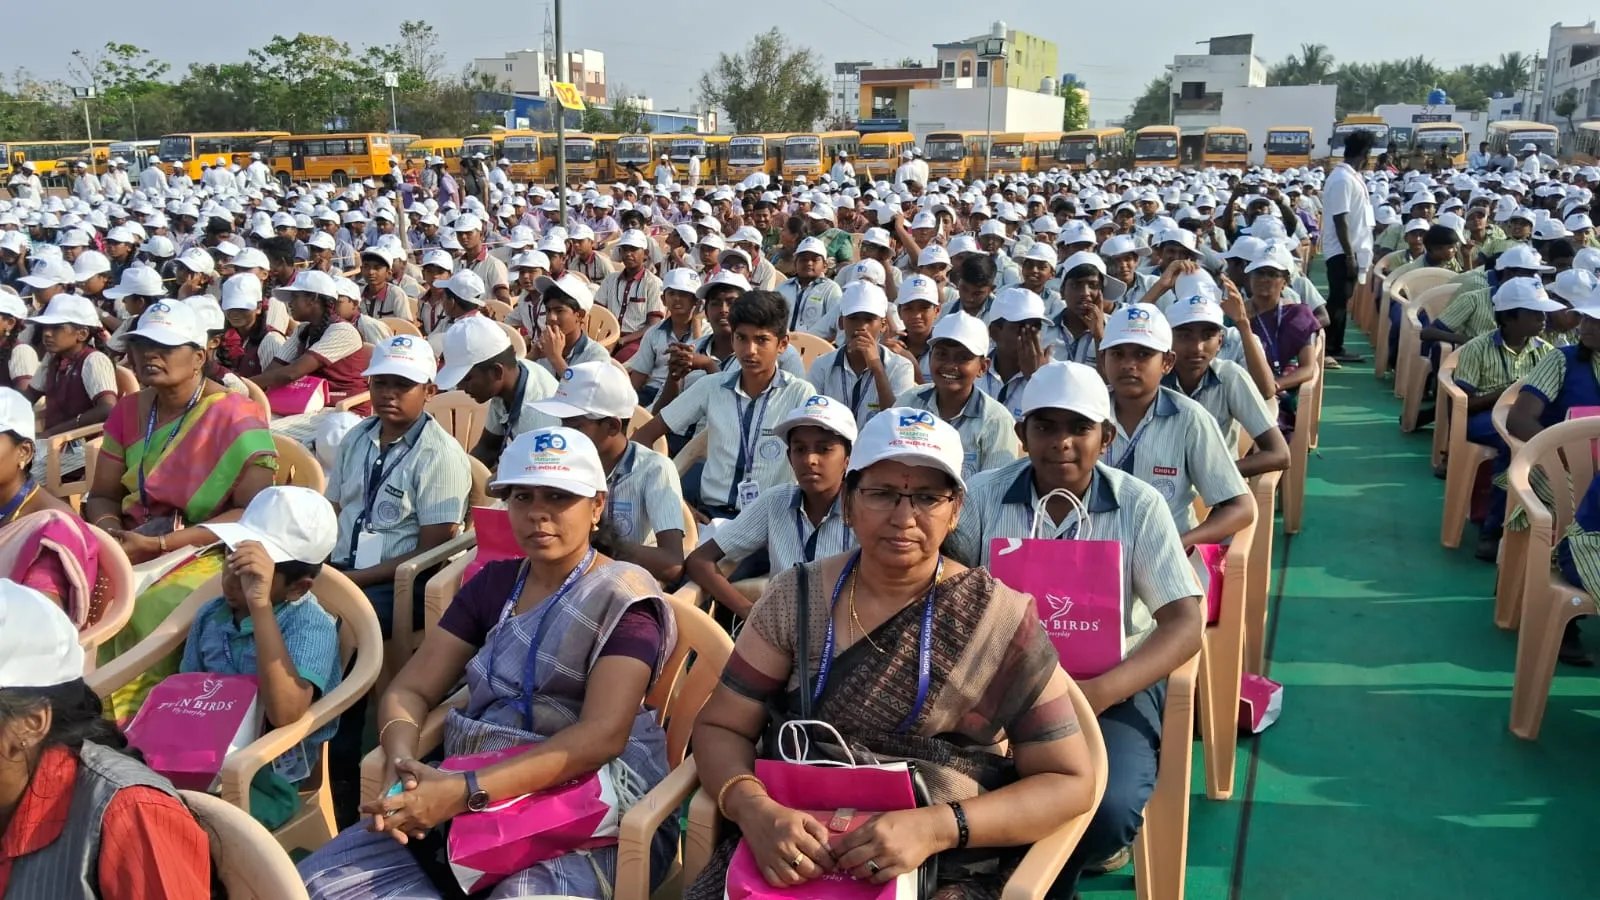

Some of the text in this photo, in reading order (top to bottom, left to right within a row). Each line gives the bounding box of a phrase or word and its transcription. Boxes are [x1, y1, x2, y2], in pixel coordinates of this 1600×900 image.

[534, 433, 567, 452] 150
[1053, 619, 1099, 631] BIRDS
[193, 701, 234, 711] BIRDS
